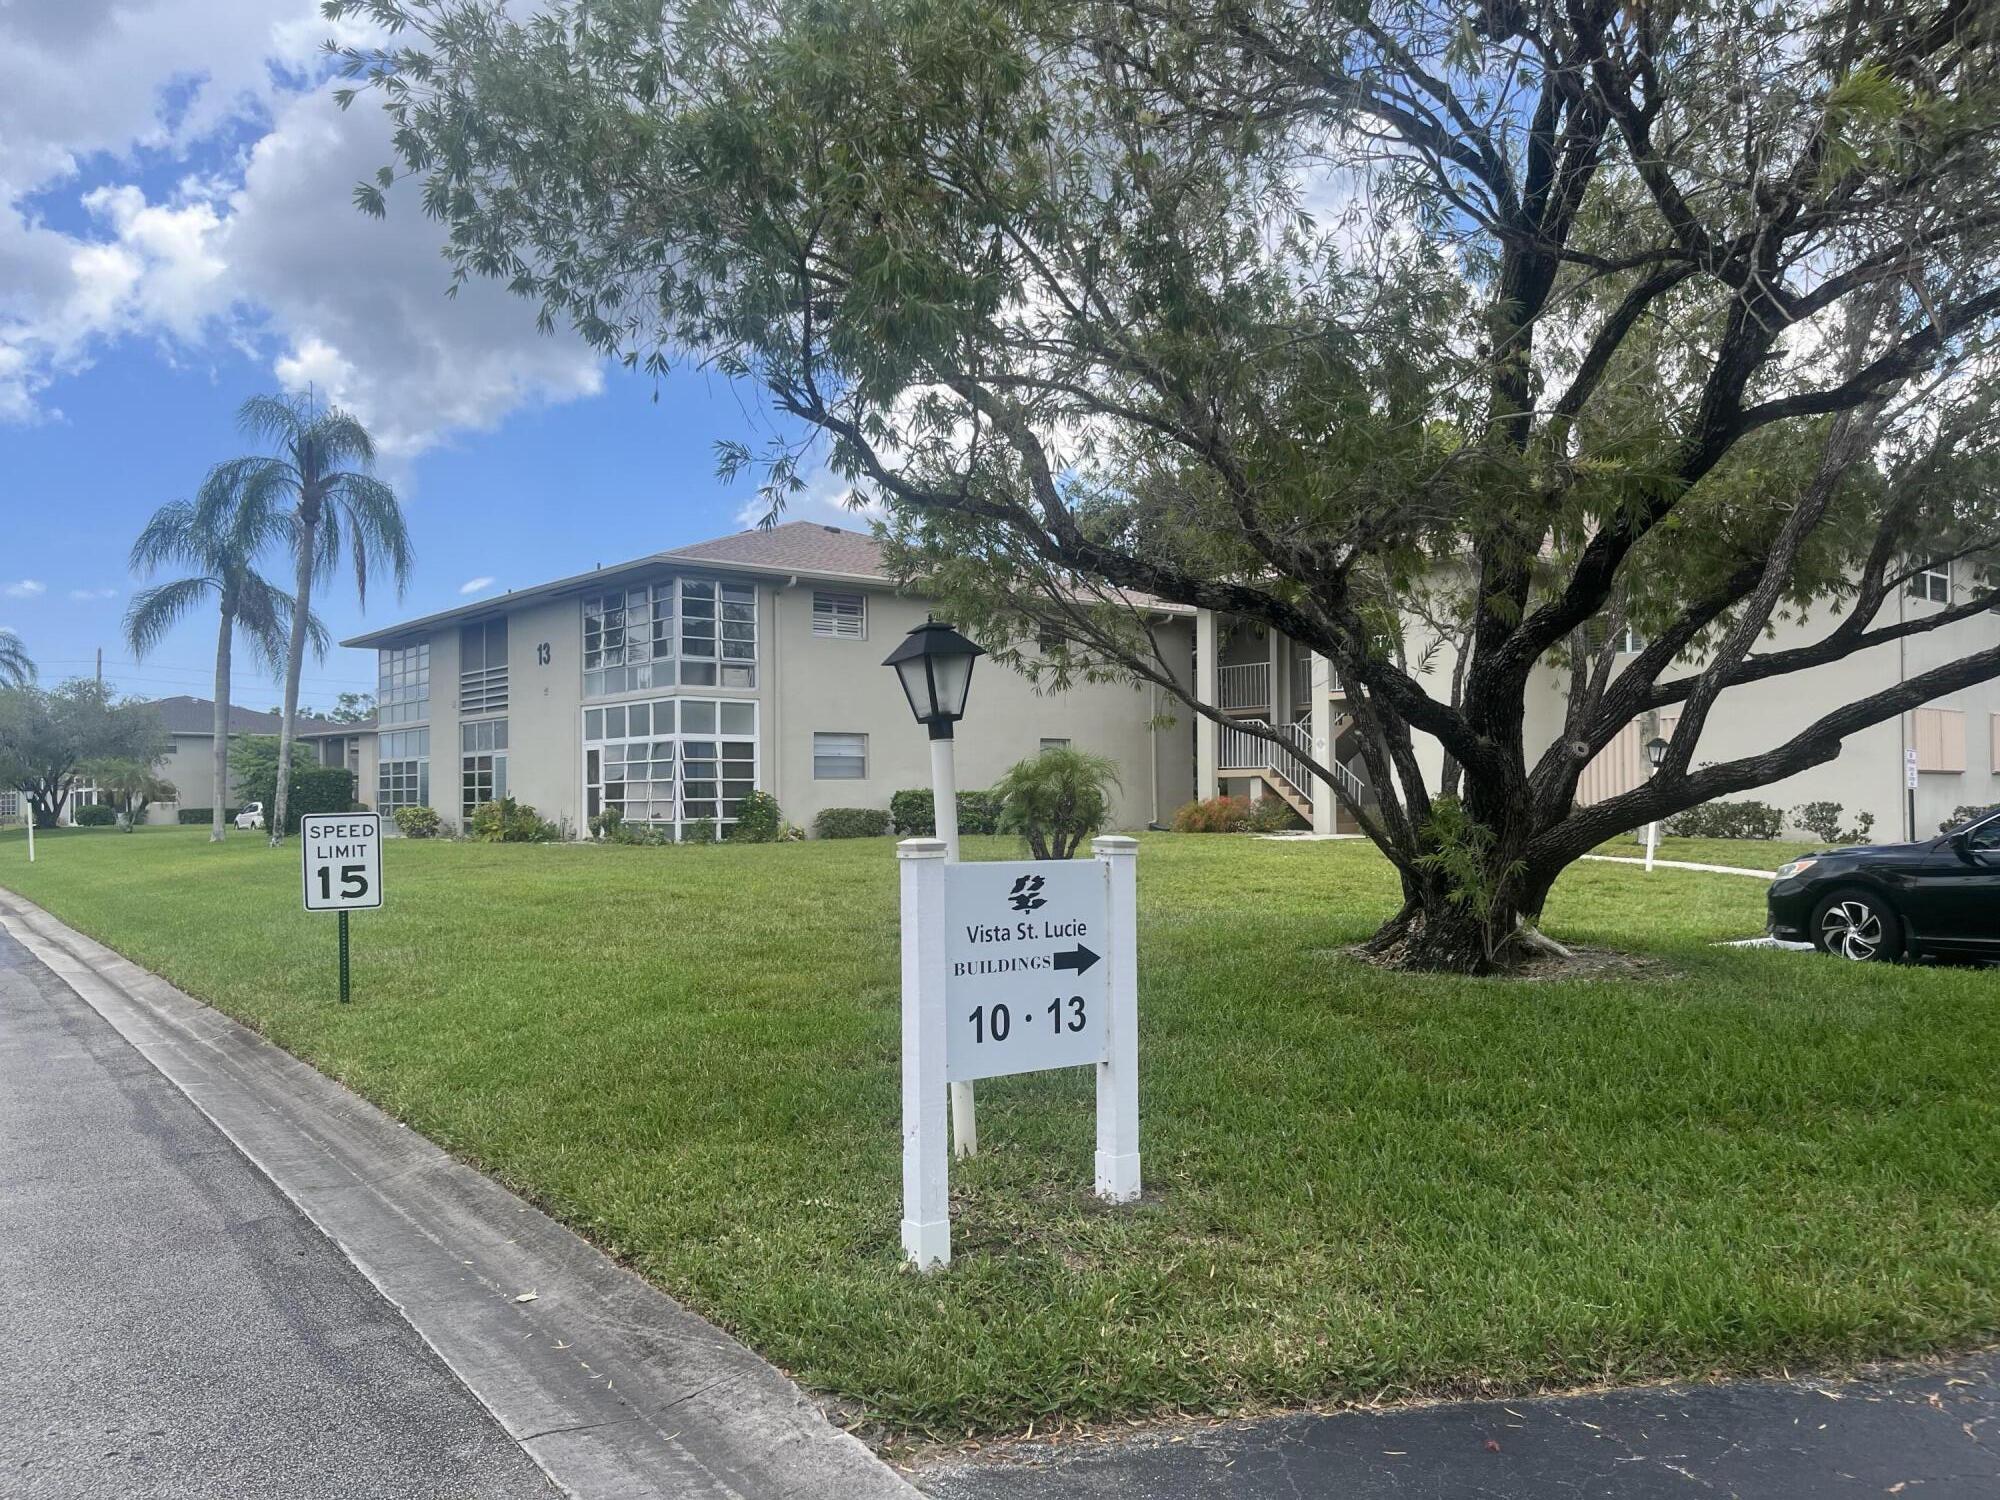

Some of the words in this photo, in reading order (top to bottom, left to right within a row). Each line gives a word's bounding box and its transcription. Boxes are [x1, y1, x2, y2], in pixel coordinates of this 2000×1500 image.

[537, 642, 550, 666] 13
[310, 824, 374, 838] SPEED
[317, 844, 367, 858] LIMIT
[317, 864, 368, 899] 15
[967, 924, 1011, 943] Vista
[1017, 922, 1039, 940] St.
[1045, 919, 1087, 938] Lucie
[954, 956, 1051, 976] BUILDINGS
[969, 1003, 1011, 1043] 10
[1047, 996, 1087, 1034] 13
